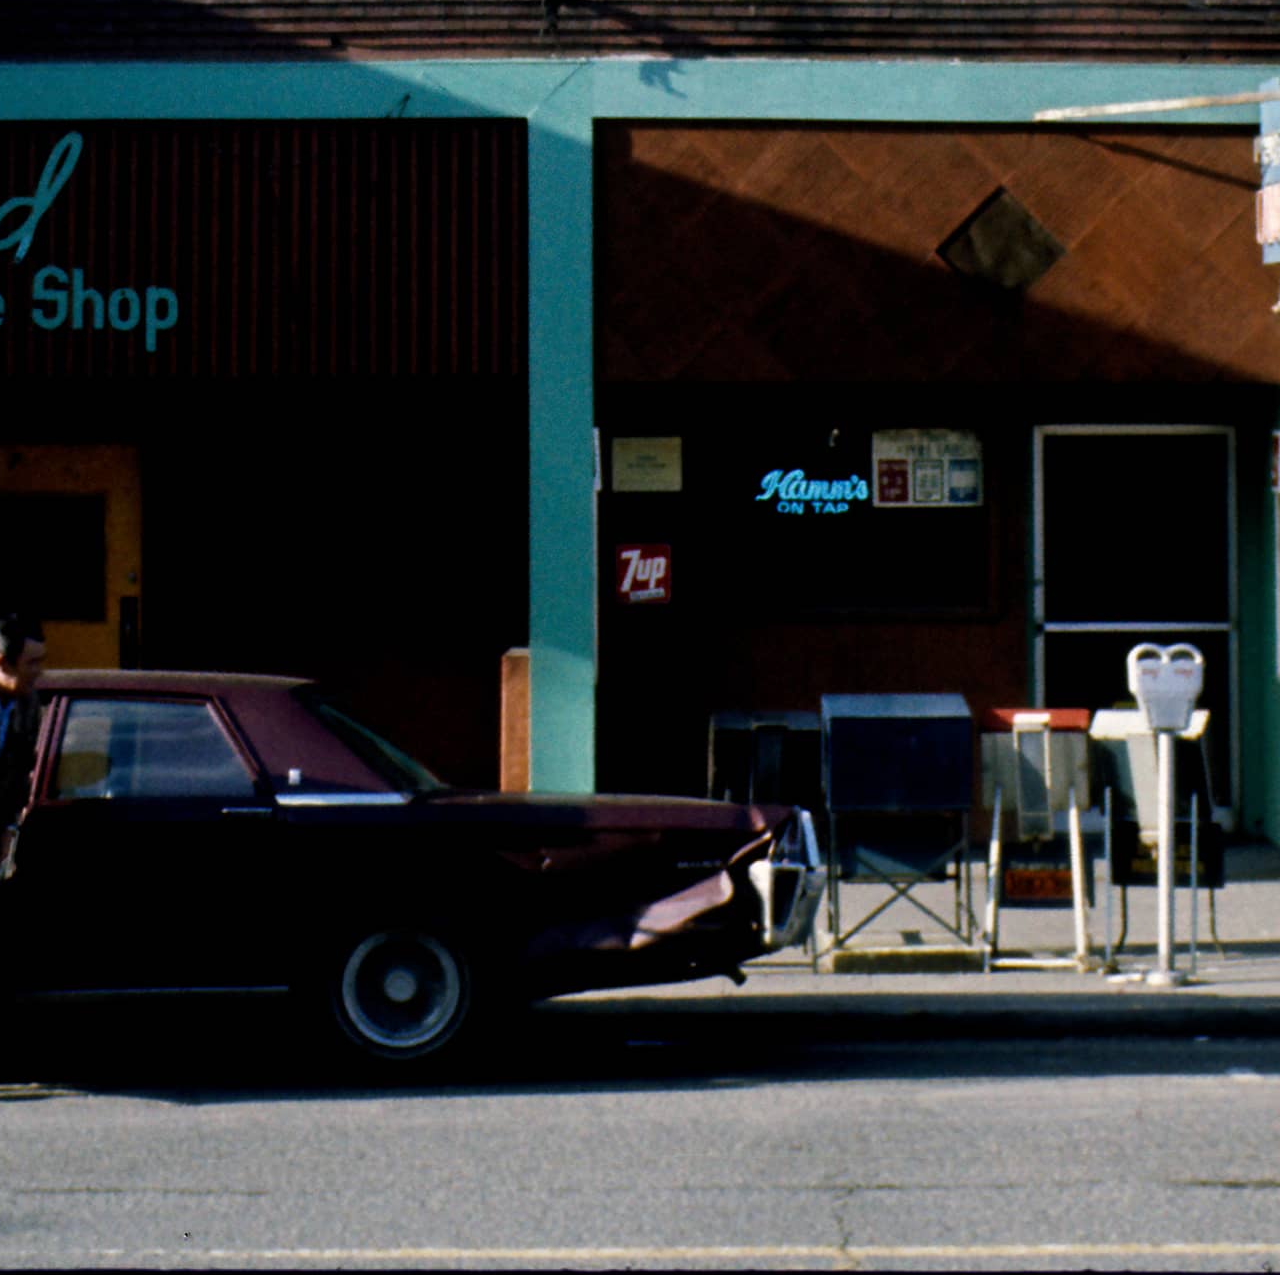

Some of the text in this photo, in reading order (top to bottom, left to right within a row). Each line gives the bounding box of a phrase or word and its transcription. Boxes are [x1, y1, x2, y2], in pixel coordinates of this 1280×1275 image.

[31, 265, 178, 352] Shop
[755, 468, 869, 502] Hamm's
[776, 501, 850, 515] ON TAP
